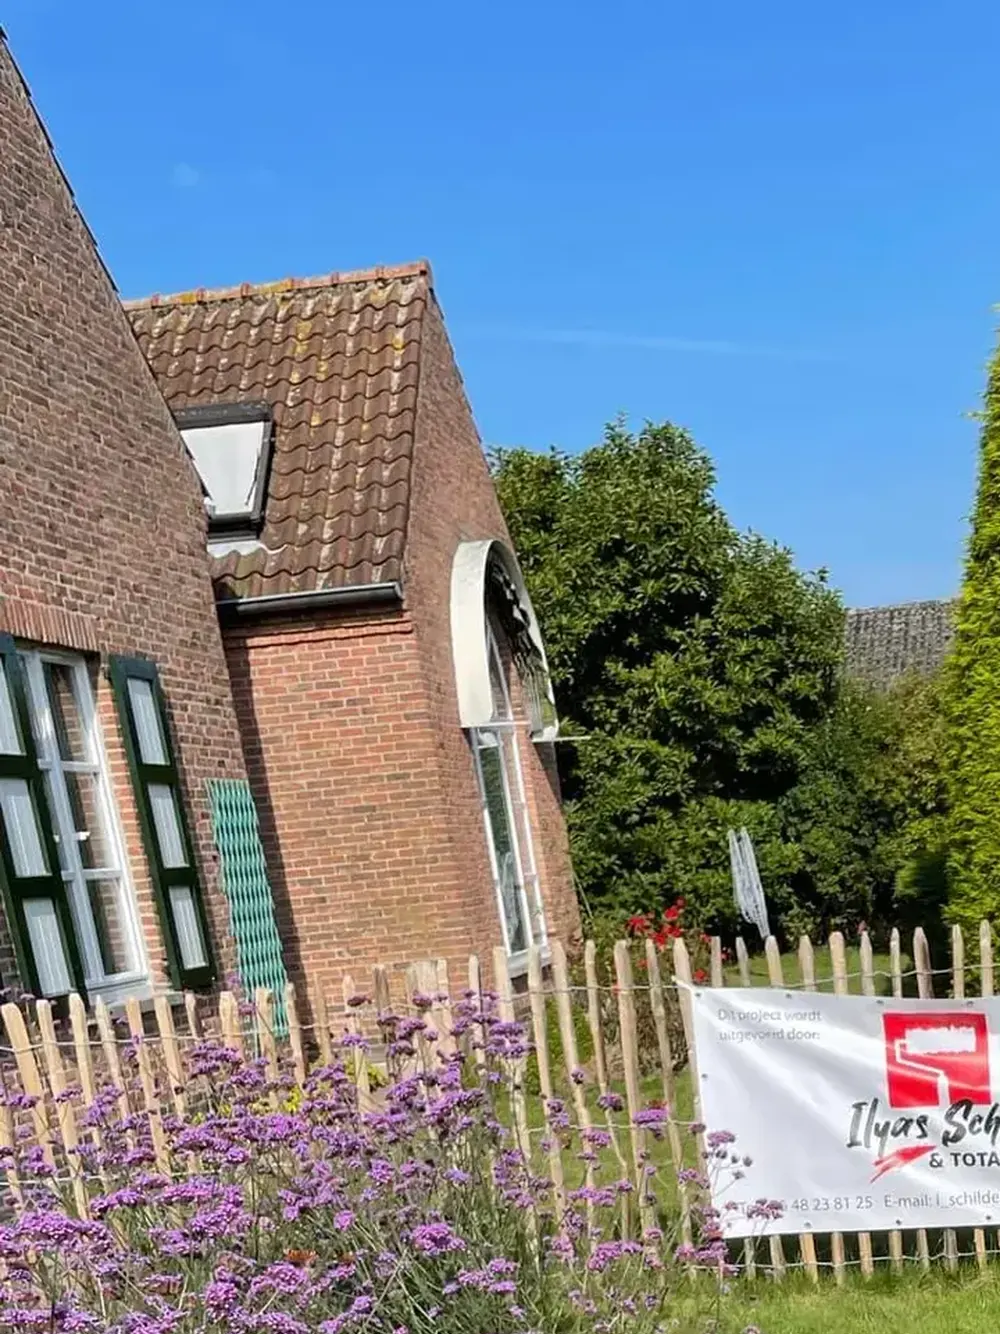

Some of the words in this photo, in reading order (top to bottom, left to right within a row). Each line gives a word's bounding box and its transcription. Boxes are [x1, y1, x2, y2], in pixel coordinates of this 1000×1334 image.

[718, 1009, 735, 1021] Dit
[738, 1009, 781, 1023] project
[784, 1010, 822, 1022] wordt
[787, 1029, 820, 1041] door:
[846, 1098, 929, 1158] Ilyas
[929, 1153, 943, 1168] &
[791, 1198, 809, 1211] 48
[812, 1197, 830, 1211] 23
[833, 1196, 850, 1210] 81
[856, 1195, 873, 1208] 25
[884, 1192, 932, 1208] E-mail:
